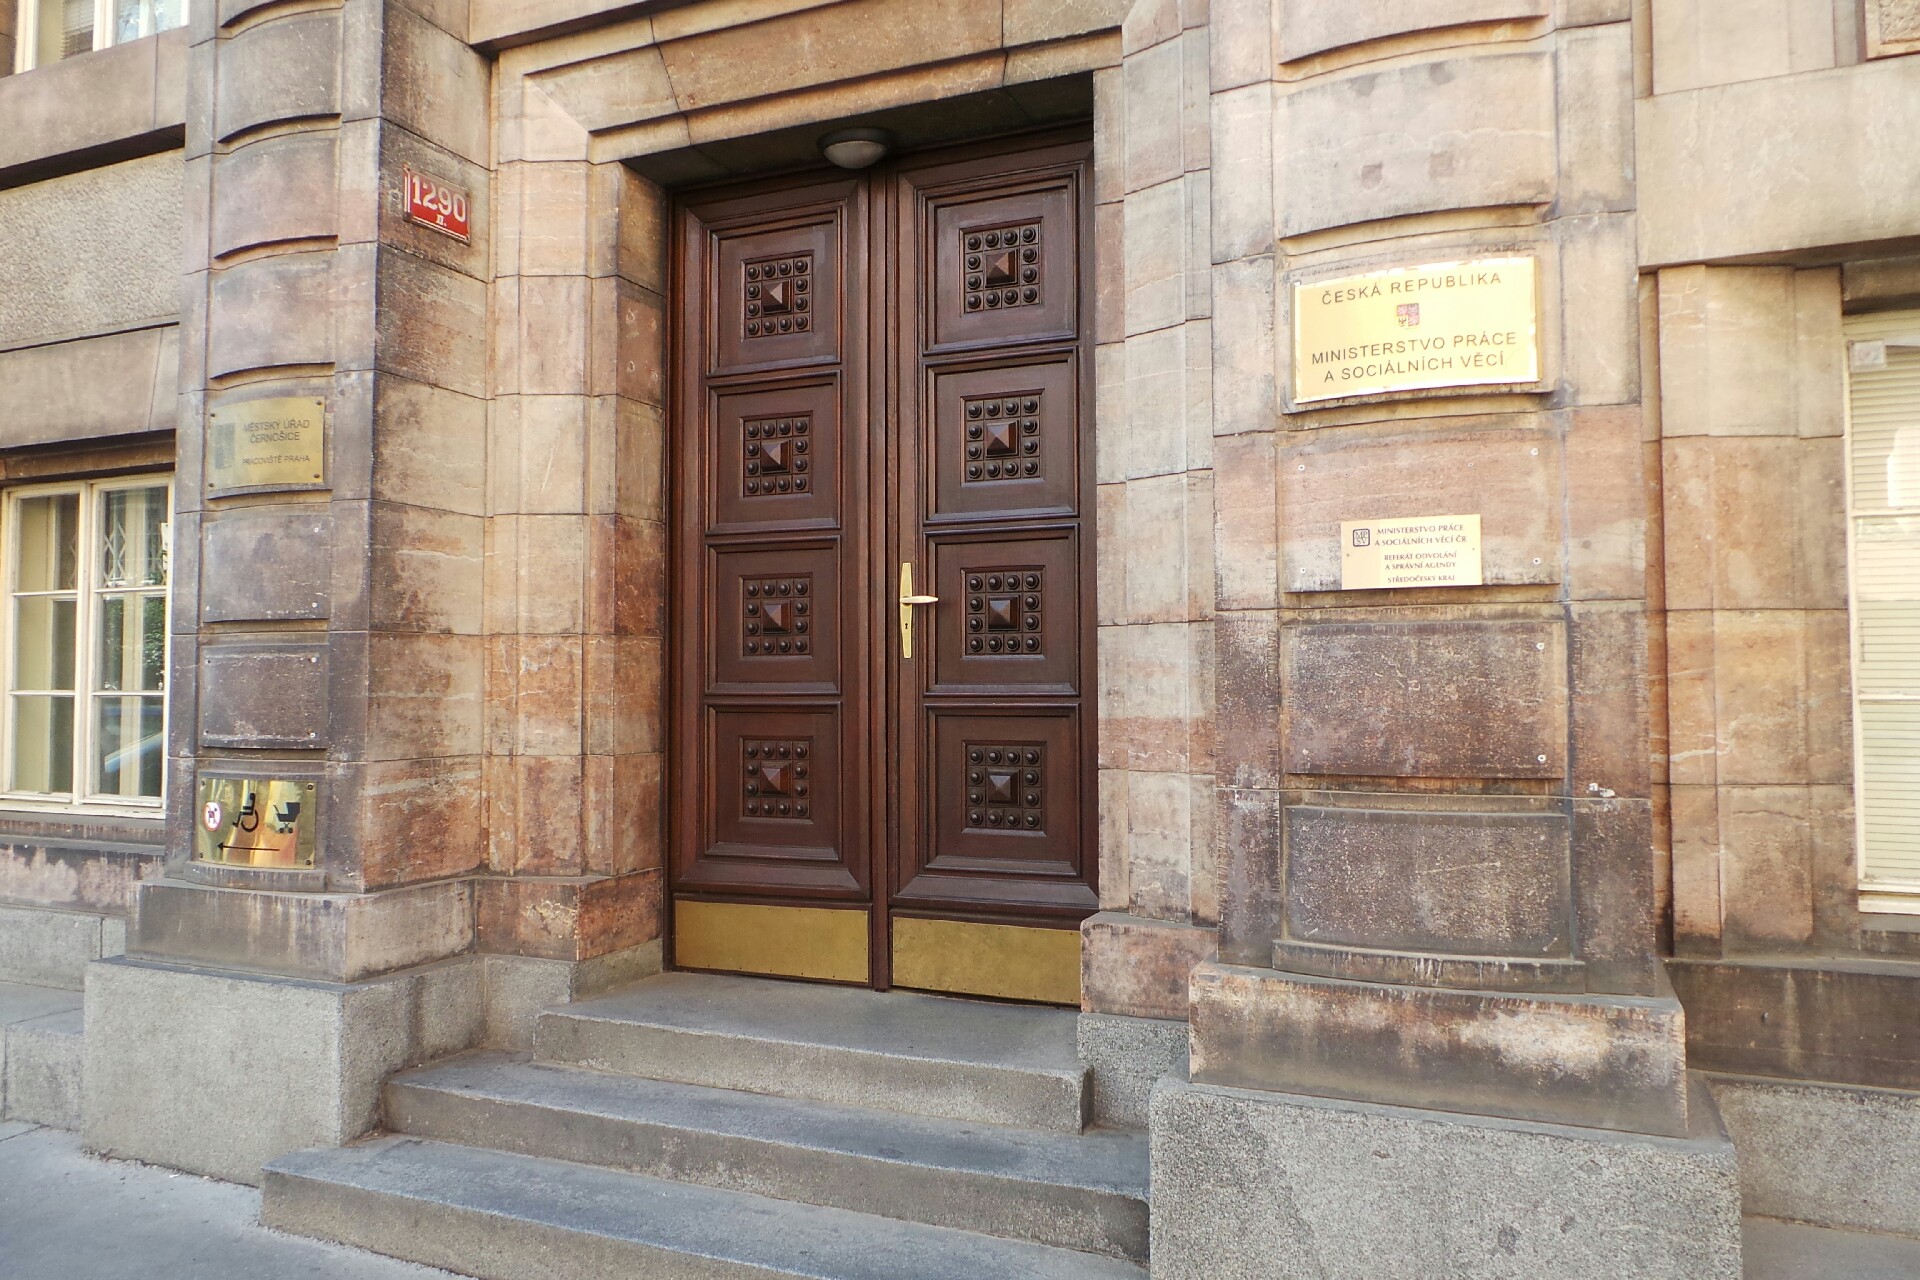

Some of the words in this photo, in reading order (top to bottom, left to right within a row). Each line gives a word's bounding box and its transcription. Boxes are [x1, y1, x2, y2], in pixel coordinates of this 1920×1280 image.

[412, 175, 466, 222] 1290
[1321, 282, 1381, 305] ČESKÁ
[1391, 272, 1501, 294] REPUBLIKA
[1312, 337, 1445, 365] MINISTERSTVO
[1453, 330, 1517, 348] PRÁCE
[1324, 370, 1335, 383] A
[1341, 356, 1453, 380] SOCIÁLNÍCH
[1460, 350, 1504, 368] VĚCÍ
[244, 420, 280, 432] MĚSTSKÝ
[283, 418, 310, 430] ÚŘAD
[250, 431, 300, 443] ČERNOŠICE
[242, 455, 282, 465] PRACOVIŠTĚ
[284, 455, 310, 463] PRAHA
[1377, 524, 1436, 535] MINISTERSTVO
[1438, 523, 1464, 532] PRÁCE
[1382, 536, 1433, 546] SOCIÁLNÍCH
[1456, 535, 1467, 543] ČR
[1384, 552, 1413, 561] REFERÁT
[1415, 550, 1457, 559] ODVOLÁNÍ
[1392, 561, 1423, 570] SPRÁVNÍ
[1425, 561, 1456, 569] AGENDY
